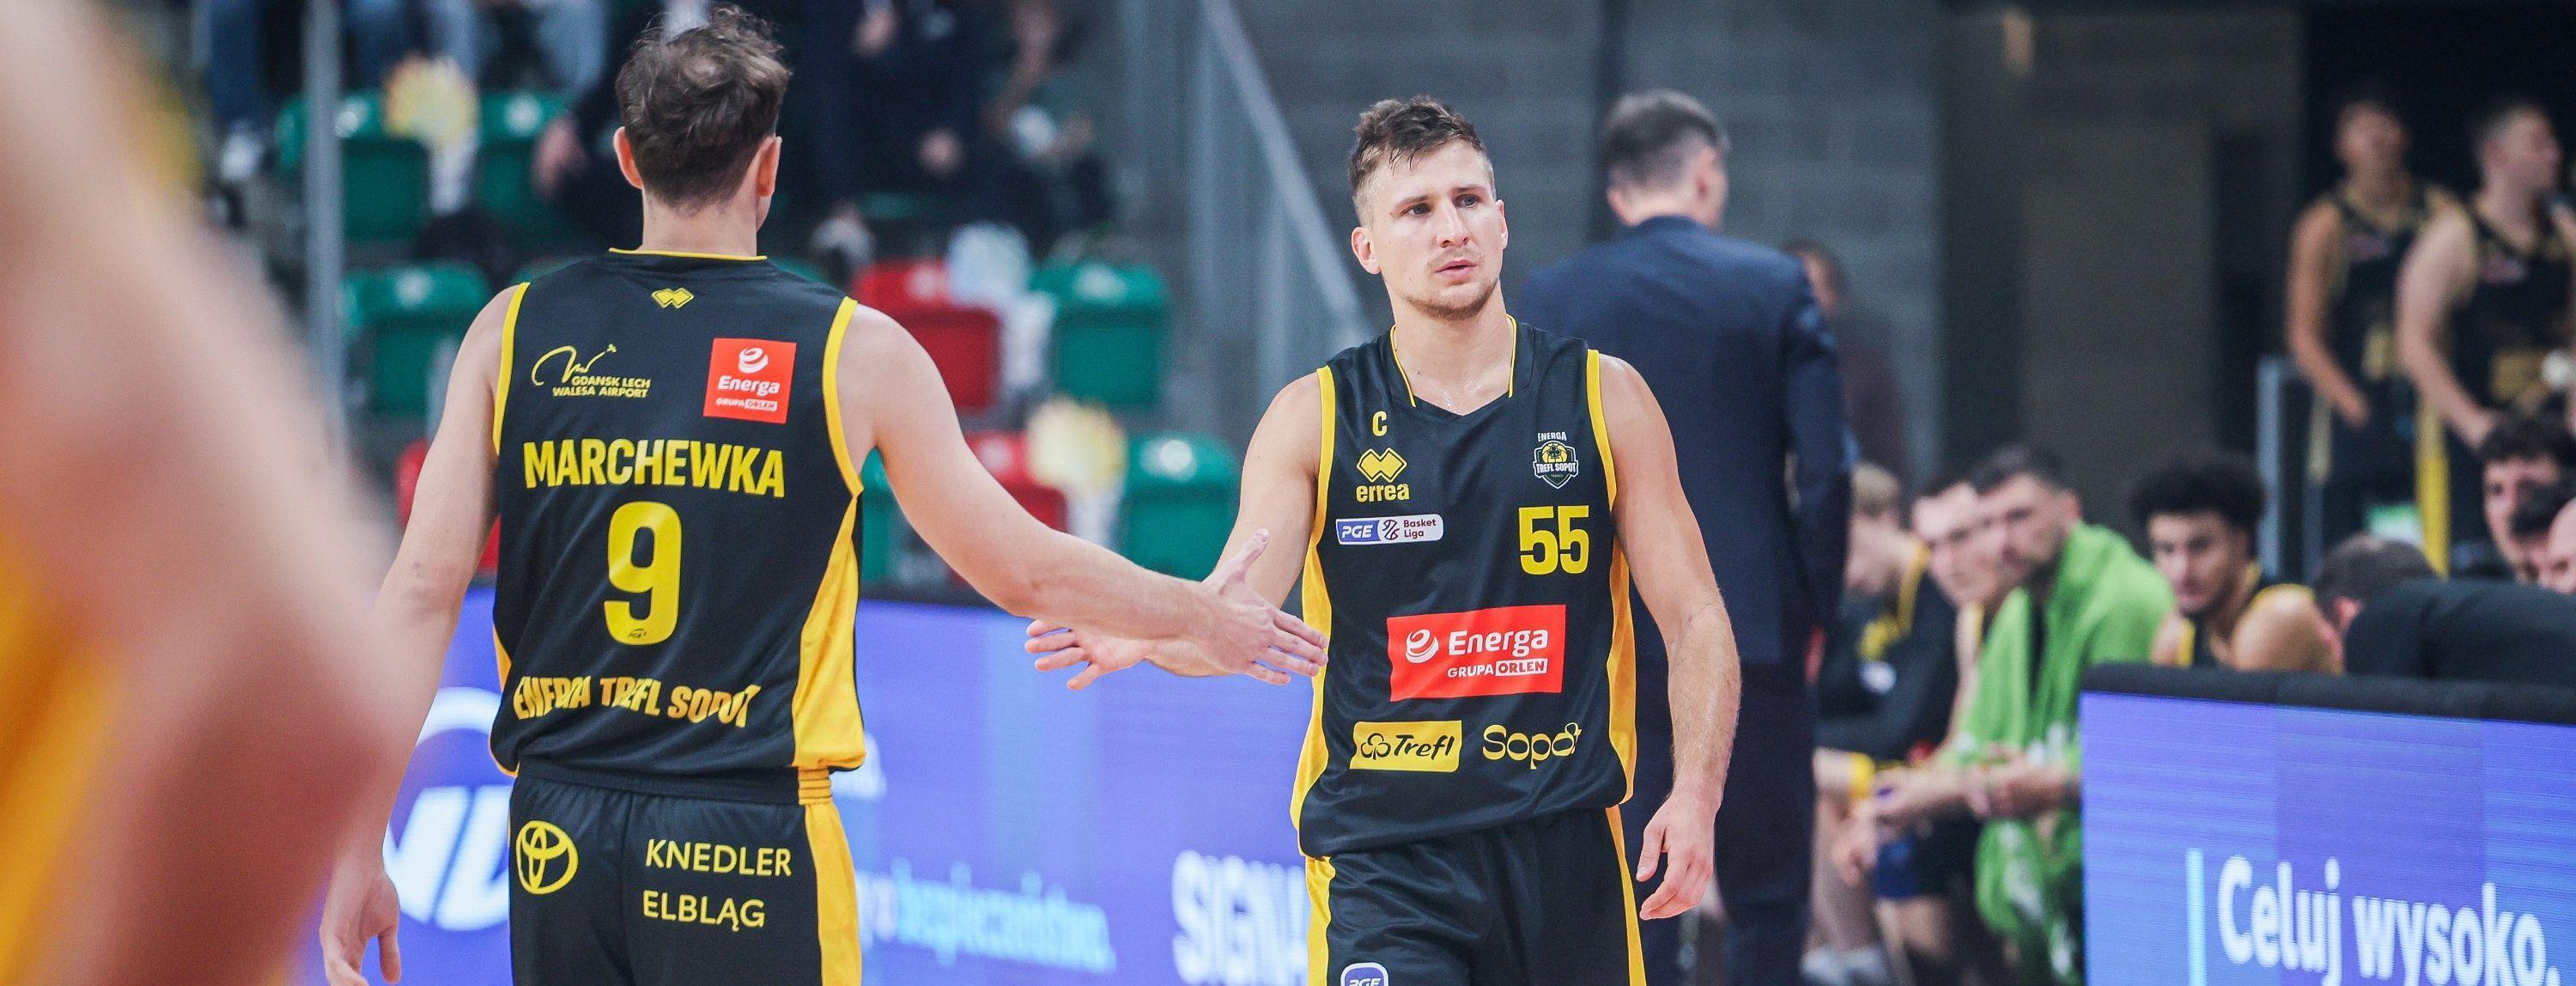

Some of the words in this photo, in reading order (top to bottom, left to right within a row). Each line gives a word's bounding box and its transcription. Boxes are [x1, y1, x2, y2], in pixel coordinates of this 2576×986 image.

[571, 375, 620, 386] GDANSK
[622, 377, 651, 388] LECH
[598, 386, 648, 398] AIRPORT
[717, 374, 781, 397] Energa
[1372, 411, 1388, 436] C
[1537, 431, 1568, 442] ENERGA
[523, 437, 785, 498] MARCHEWKA
[1536, 463, 1555, 473] TREFL
[1555, 462, 1577, 472] SOPOT
[1341, 525, 1373, 539] PGE
[1403, 518, 1437, 528] Basket
[1404, 529, 1425, 539] Liga
[1519, 505, 1589, 575] 55
[604, 501, 682, 645] 9
[1449, 629, 1548, 657] Energa
[1447, 664, 1494, 678] GRUPA
[1498, 660, 1546, 674] ORLEN
[1393, 733, 1455, 758] Trefl
[1482, 722, 1583, 770] Sopot
[645, 838, 792, 877] KNEDLER
[642, 890, 766, 932] ELBLĄG
[2217, 855, 2342, 986] Celuj
[2352, 882, 2561, 986] wysoko.
